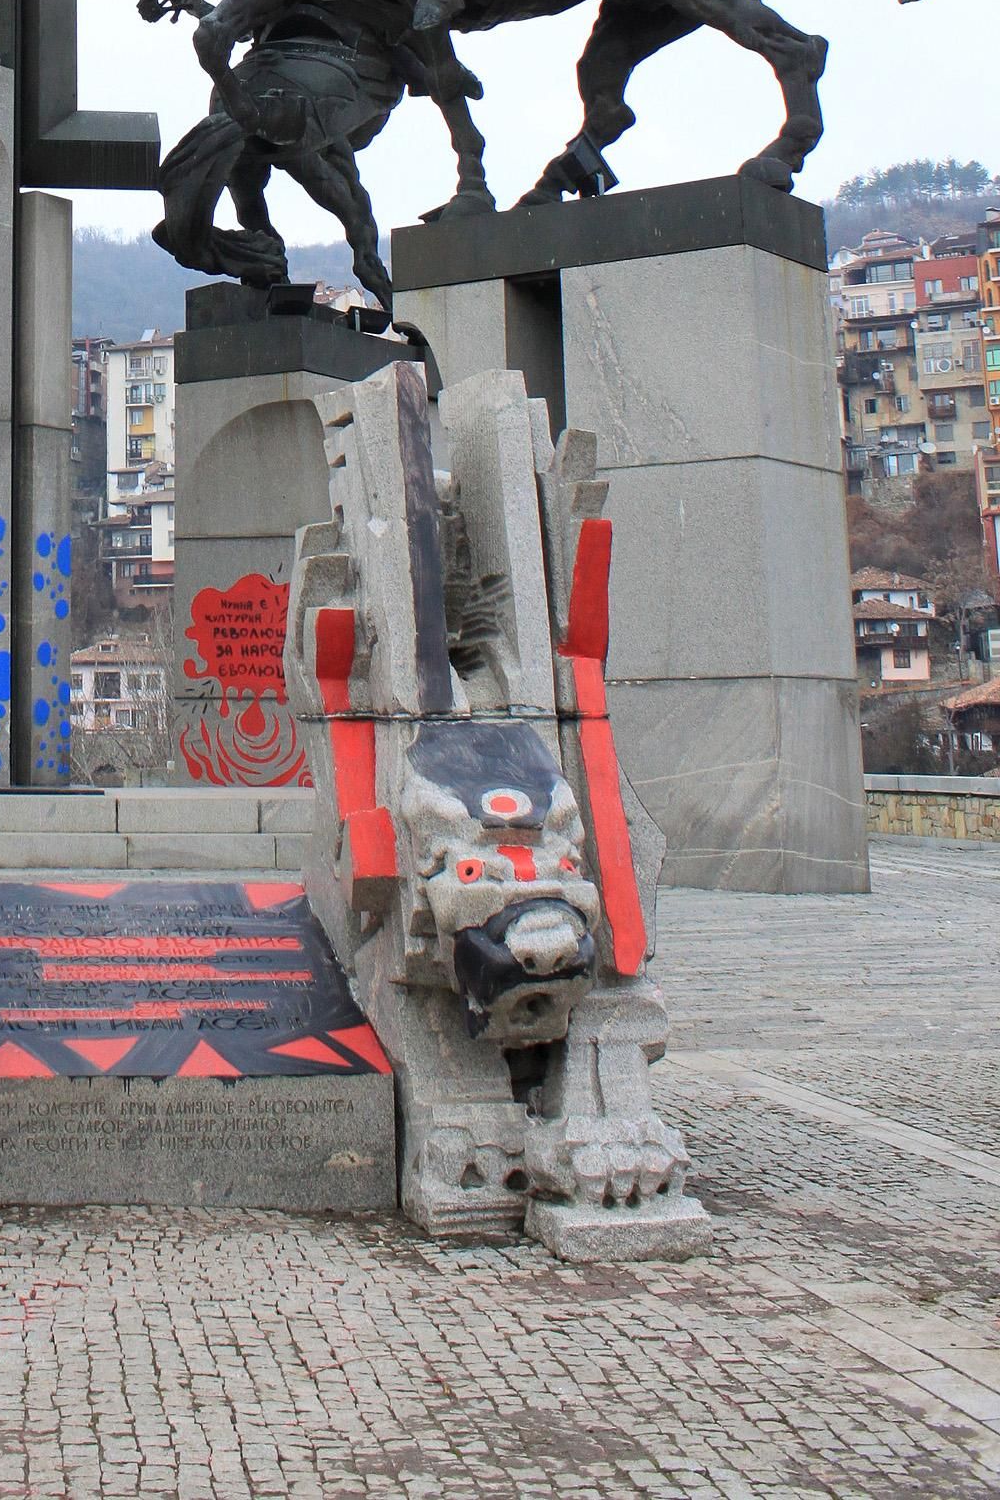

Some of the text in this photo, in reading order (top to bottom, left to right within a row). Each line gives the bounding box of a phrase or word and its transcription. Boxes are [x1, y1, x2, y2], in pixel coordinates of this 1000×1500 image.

[213, 627, 286, 639] РЕВОЛЮЦ
[216, 645, 233, 657] ЗА
[218, 664, 285, 679] ЕВОЛЮЦ
[147, 987, 227, 1000] АСЕН
[108, 1017, 185, 1031] ИВАН
[197, 1016, 281, 1031] АСЕН
